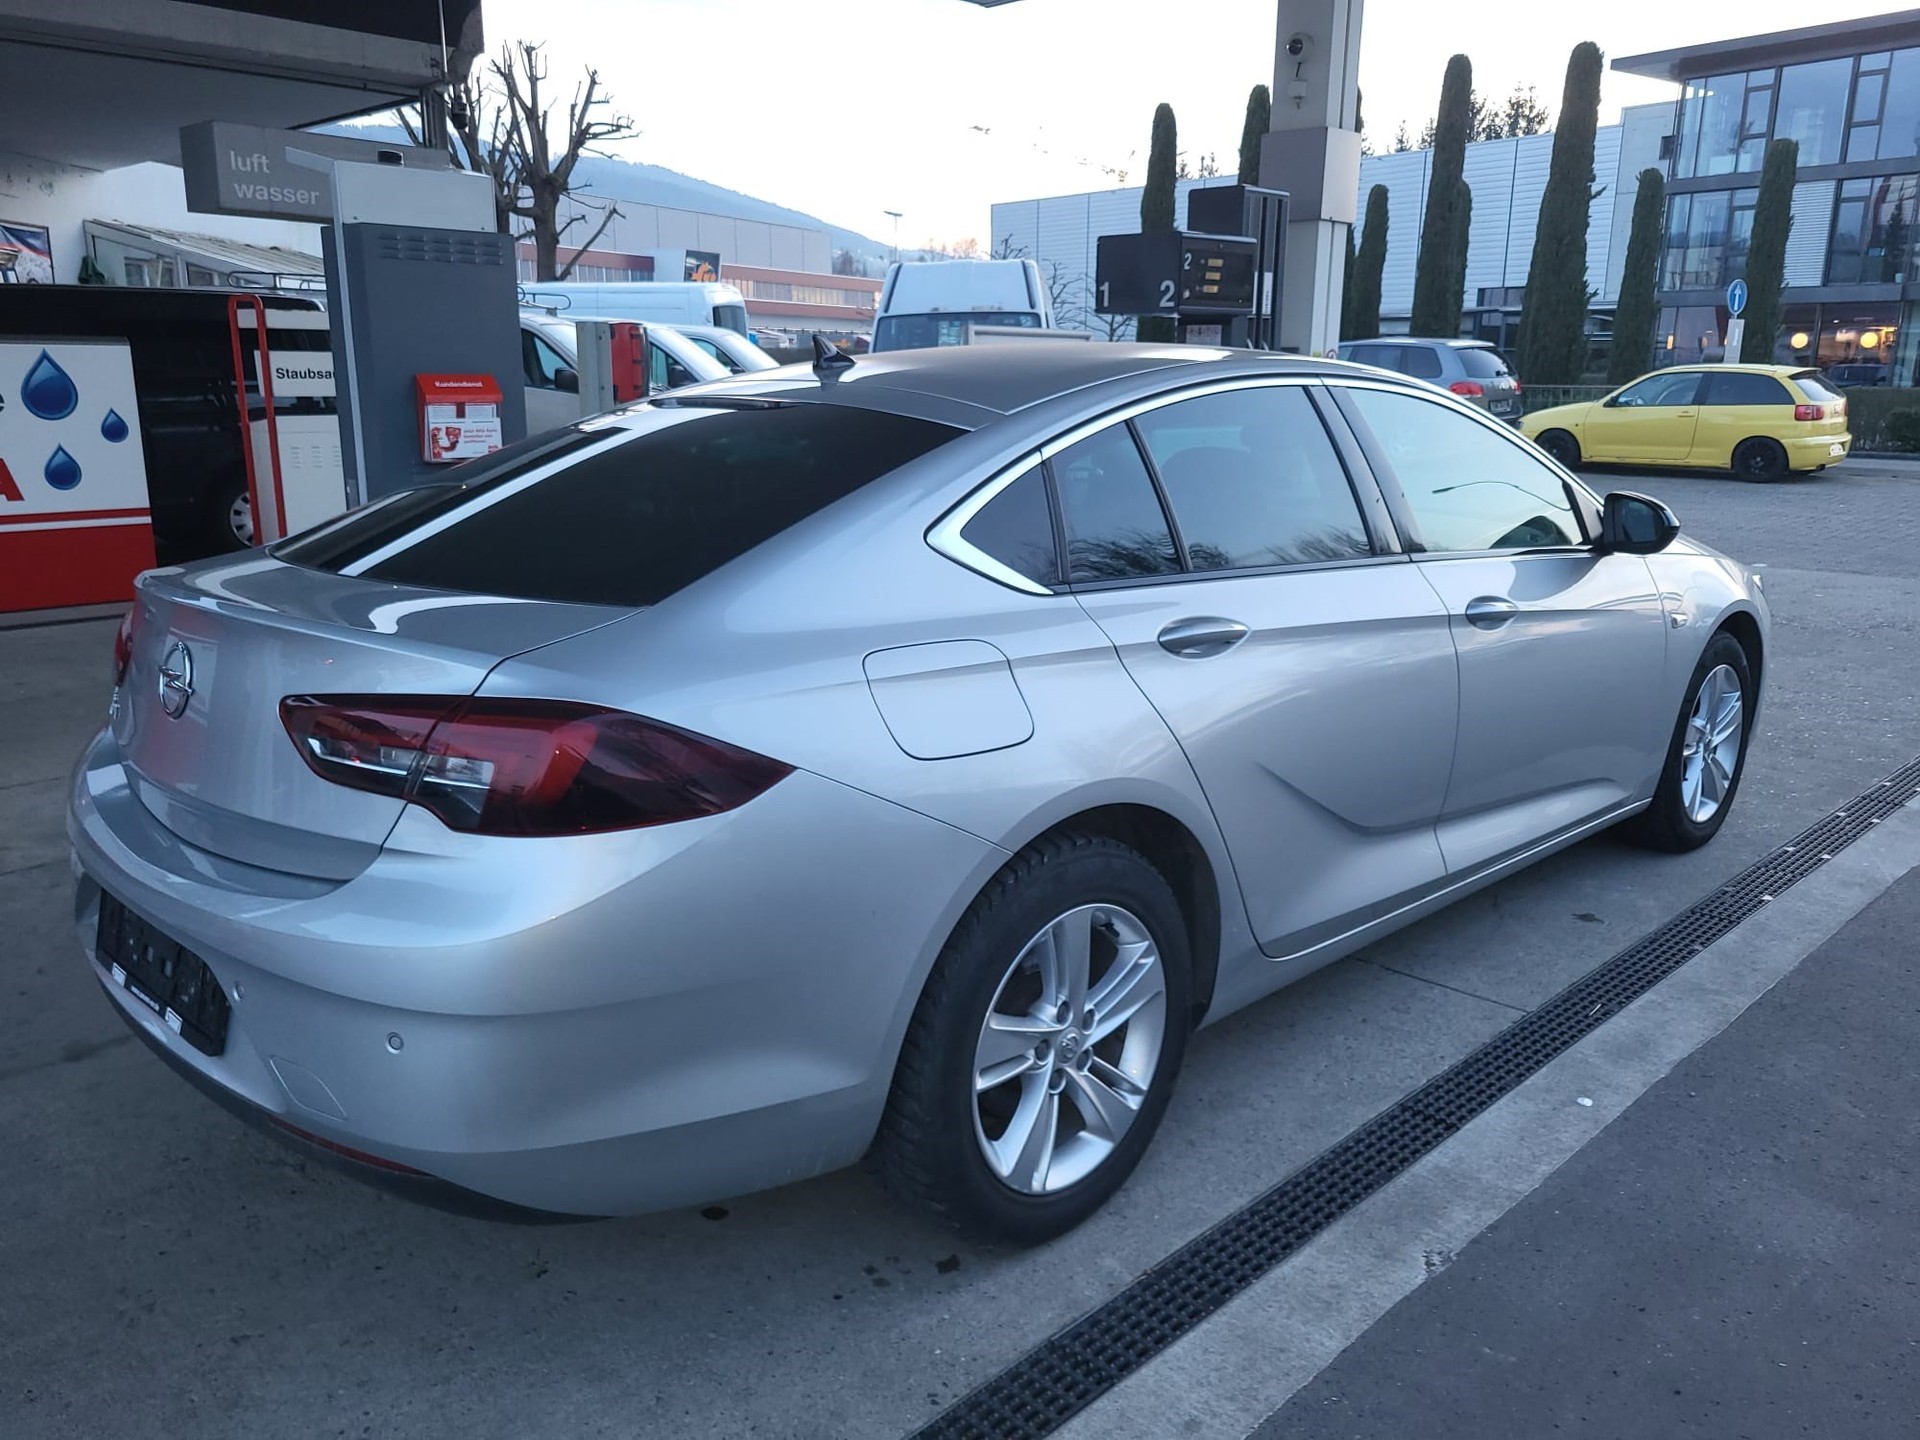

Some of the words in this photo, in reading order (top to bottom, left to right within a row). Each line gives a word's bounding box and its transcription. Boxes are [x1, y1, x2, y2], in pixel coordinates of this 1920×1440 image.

[230, 151, 270, 174] luft
[234, 183, 319, 205] wasser
[1183, 252, 1192, 270] 2
[1100, 281, 1110, 307] 1
[1159, 280, 1175, 307] 2
[275, 367, 335, 380] Staubsa
